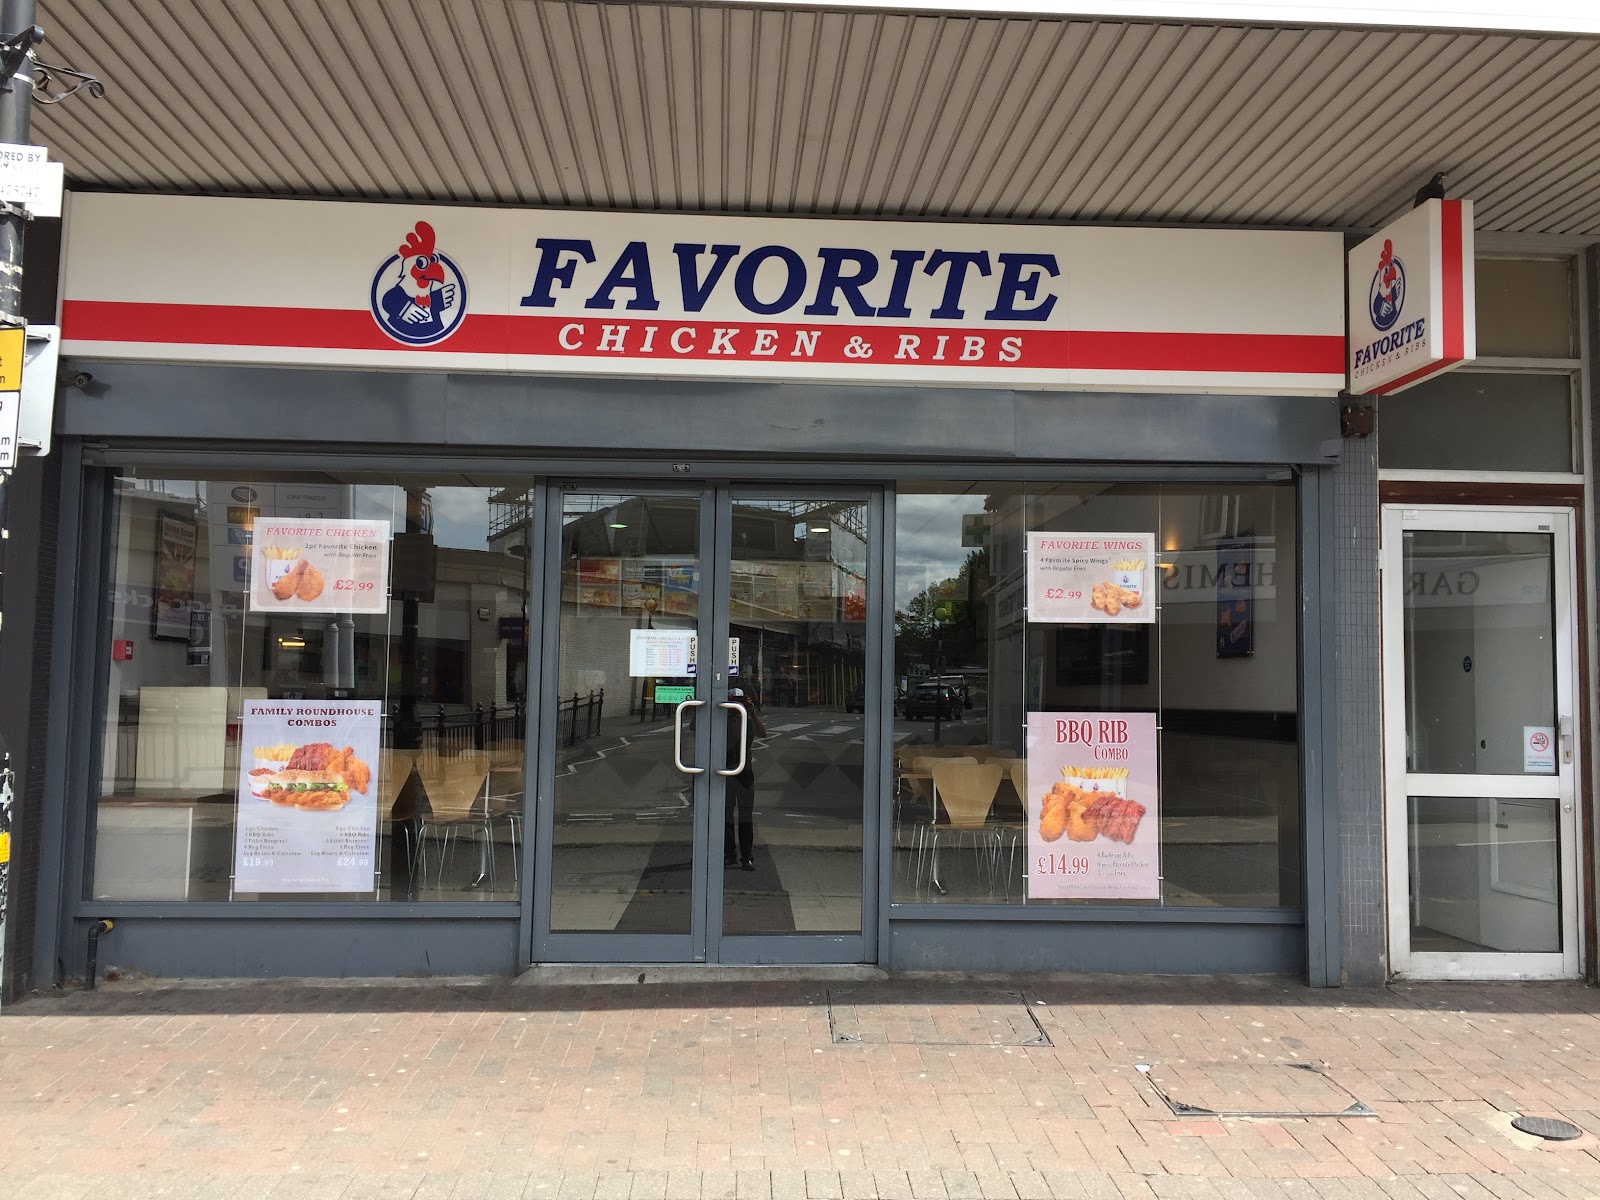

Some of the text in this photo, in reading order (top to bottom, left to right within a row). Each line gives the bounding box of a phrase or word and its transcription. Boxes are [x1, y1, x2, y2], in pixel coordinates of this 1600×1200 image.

[28, 153, 41, 163] BY
[520, 238, 1062, 321] FAVORITE
[557, 323, 1024, 363] CHICKEN & RIBS
[1354, 318, 1426, 370] FAVORITE
[1354, 338, 1427, 379] CHICKEN & RIBS
[266, 527, 377, 538] FAVORITE CHICKEN
[304, 543, 317, 551] 2pc
[1040, 540, 1143, 550] FAVORITE WINGS
[1072, 557, 1088, 565] Spicy
[332, 579, 374, 591] £2.99
[1044, 588, 1082, 600] £2.99
[251, 708, 374, 716] FAMILY ROUNDHOUSE
[287, 719, 337, 727] COMBOS
[1055, 719, 1129, 747] BBQ RIB
[243, 857, 274, 867] £19.99
[337, 857, 369, 867] £24.99
[1037, 853, 1090, 875] £14.99
